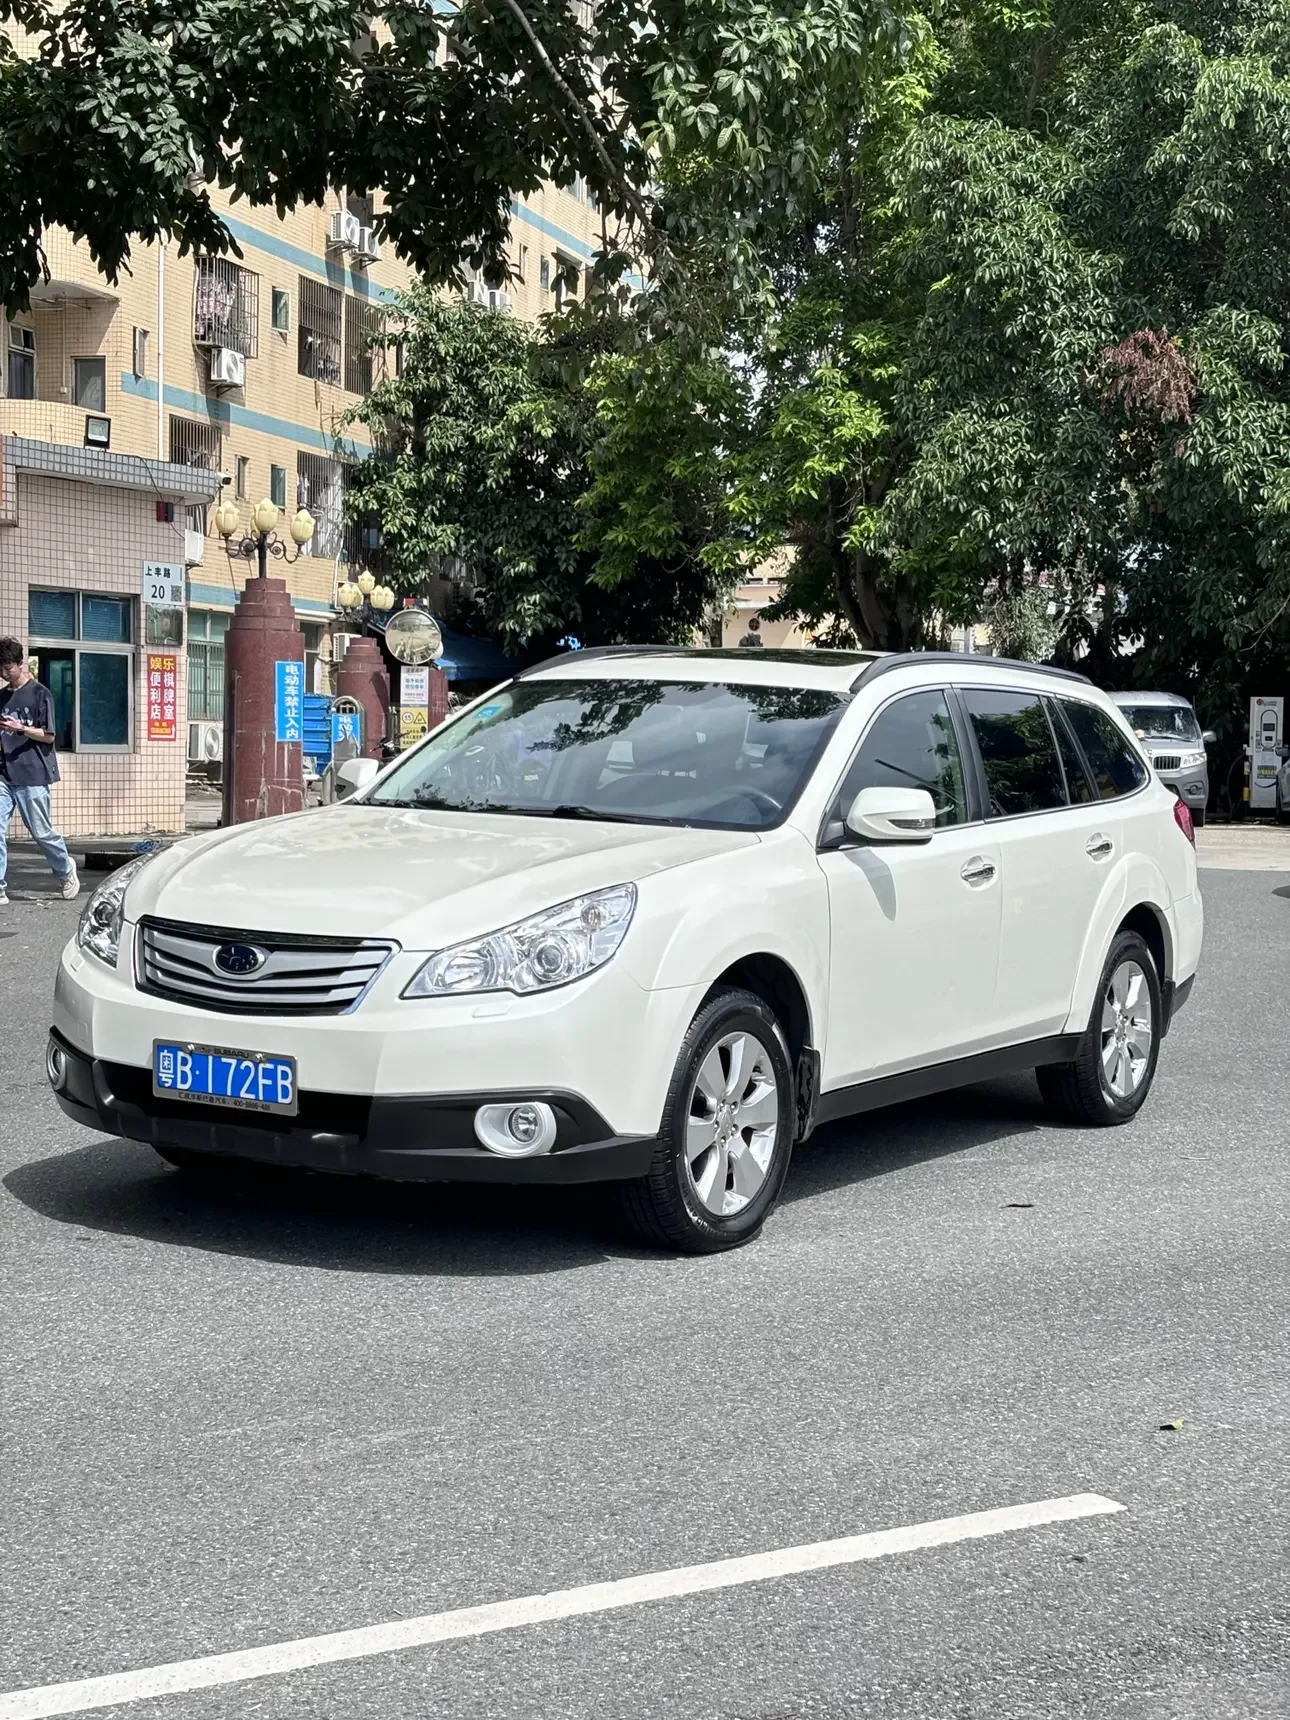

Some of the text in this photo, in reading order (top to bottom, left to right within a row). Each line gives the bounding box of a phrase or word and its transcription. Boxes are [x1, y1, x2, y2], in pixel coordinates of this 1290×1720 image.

[145, 565, 170, 578] 上丰路
[151, 584, 165, 599] 20
[150, 657, 175, 670] 娱乐
[150, 672, 161, 719] 便利店
[163, 671, 175, 720] 棋牌室
[284, 663, 300, 739] 电动车禁止入内
[213, 1048, 249, 1059] SUBARU
